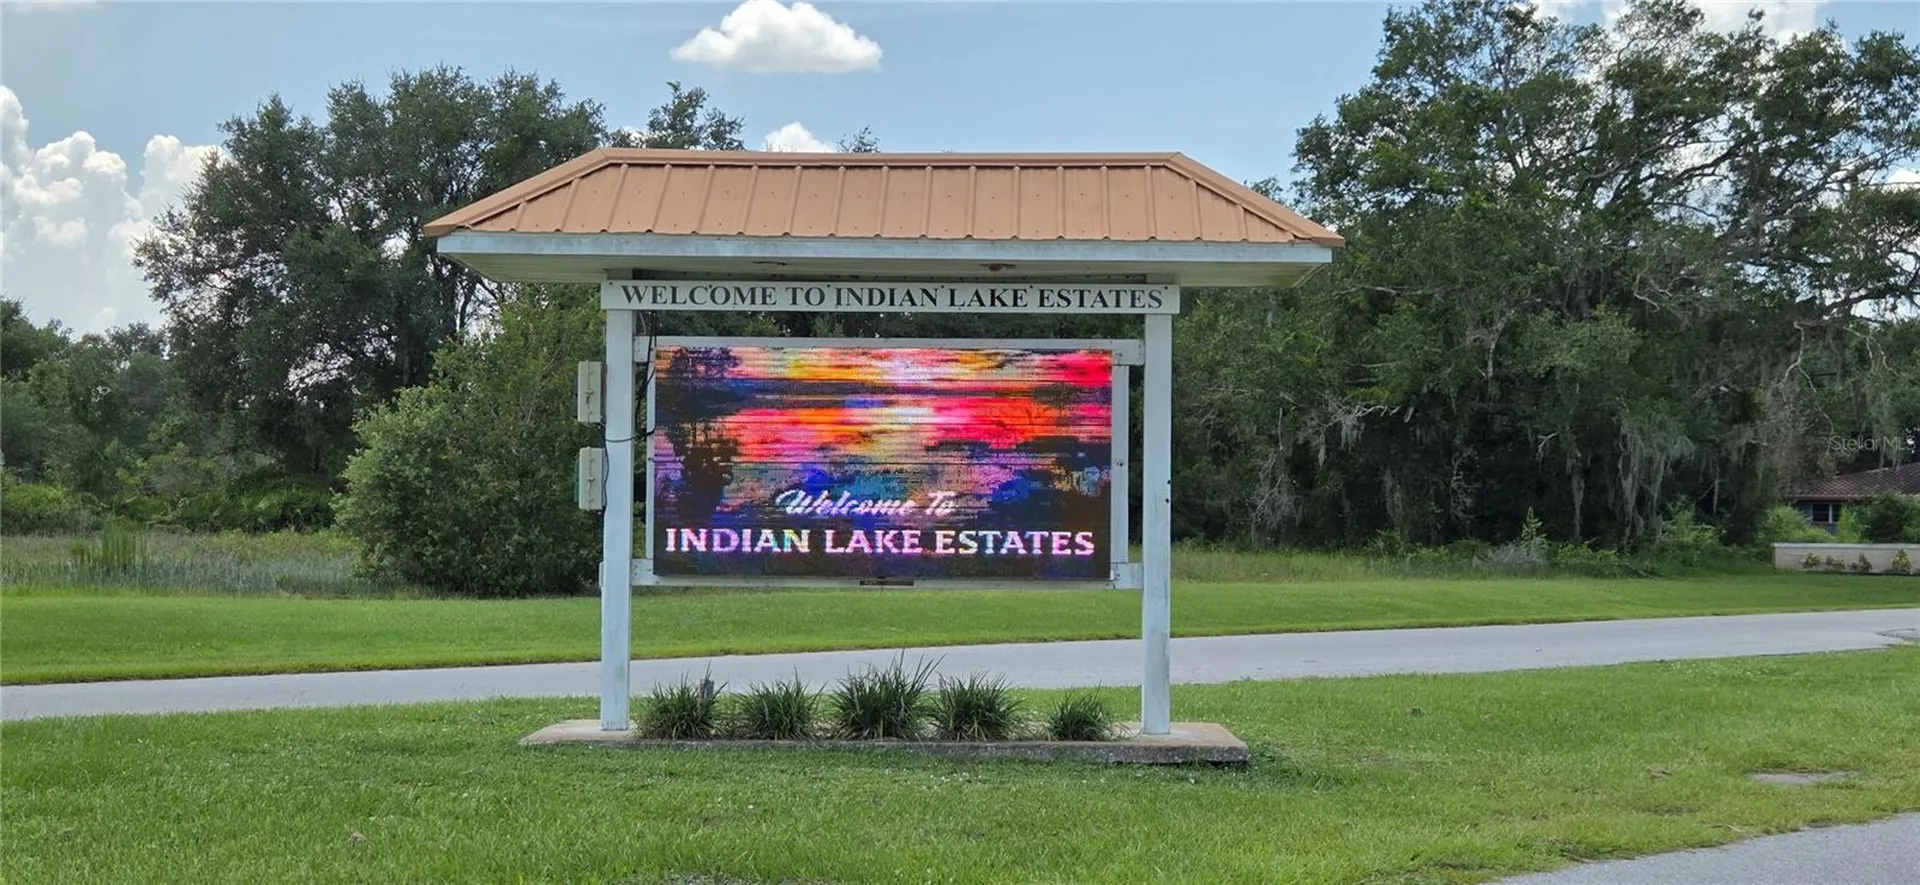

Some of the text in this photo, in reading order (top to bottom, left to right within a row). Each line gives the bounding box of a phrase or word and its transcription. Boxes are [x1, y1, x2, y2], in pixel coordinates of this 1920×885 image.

[621, 285, 1162, 309] WELCOME TO INDIAN LAKE ESTATES
[775, 489, 957, 517] Welcome To
[665, 528, 1096, 555] INDIAN LAKE ESTATES
